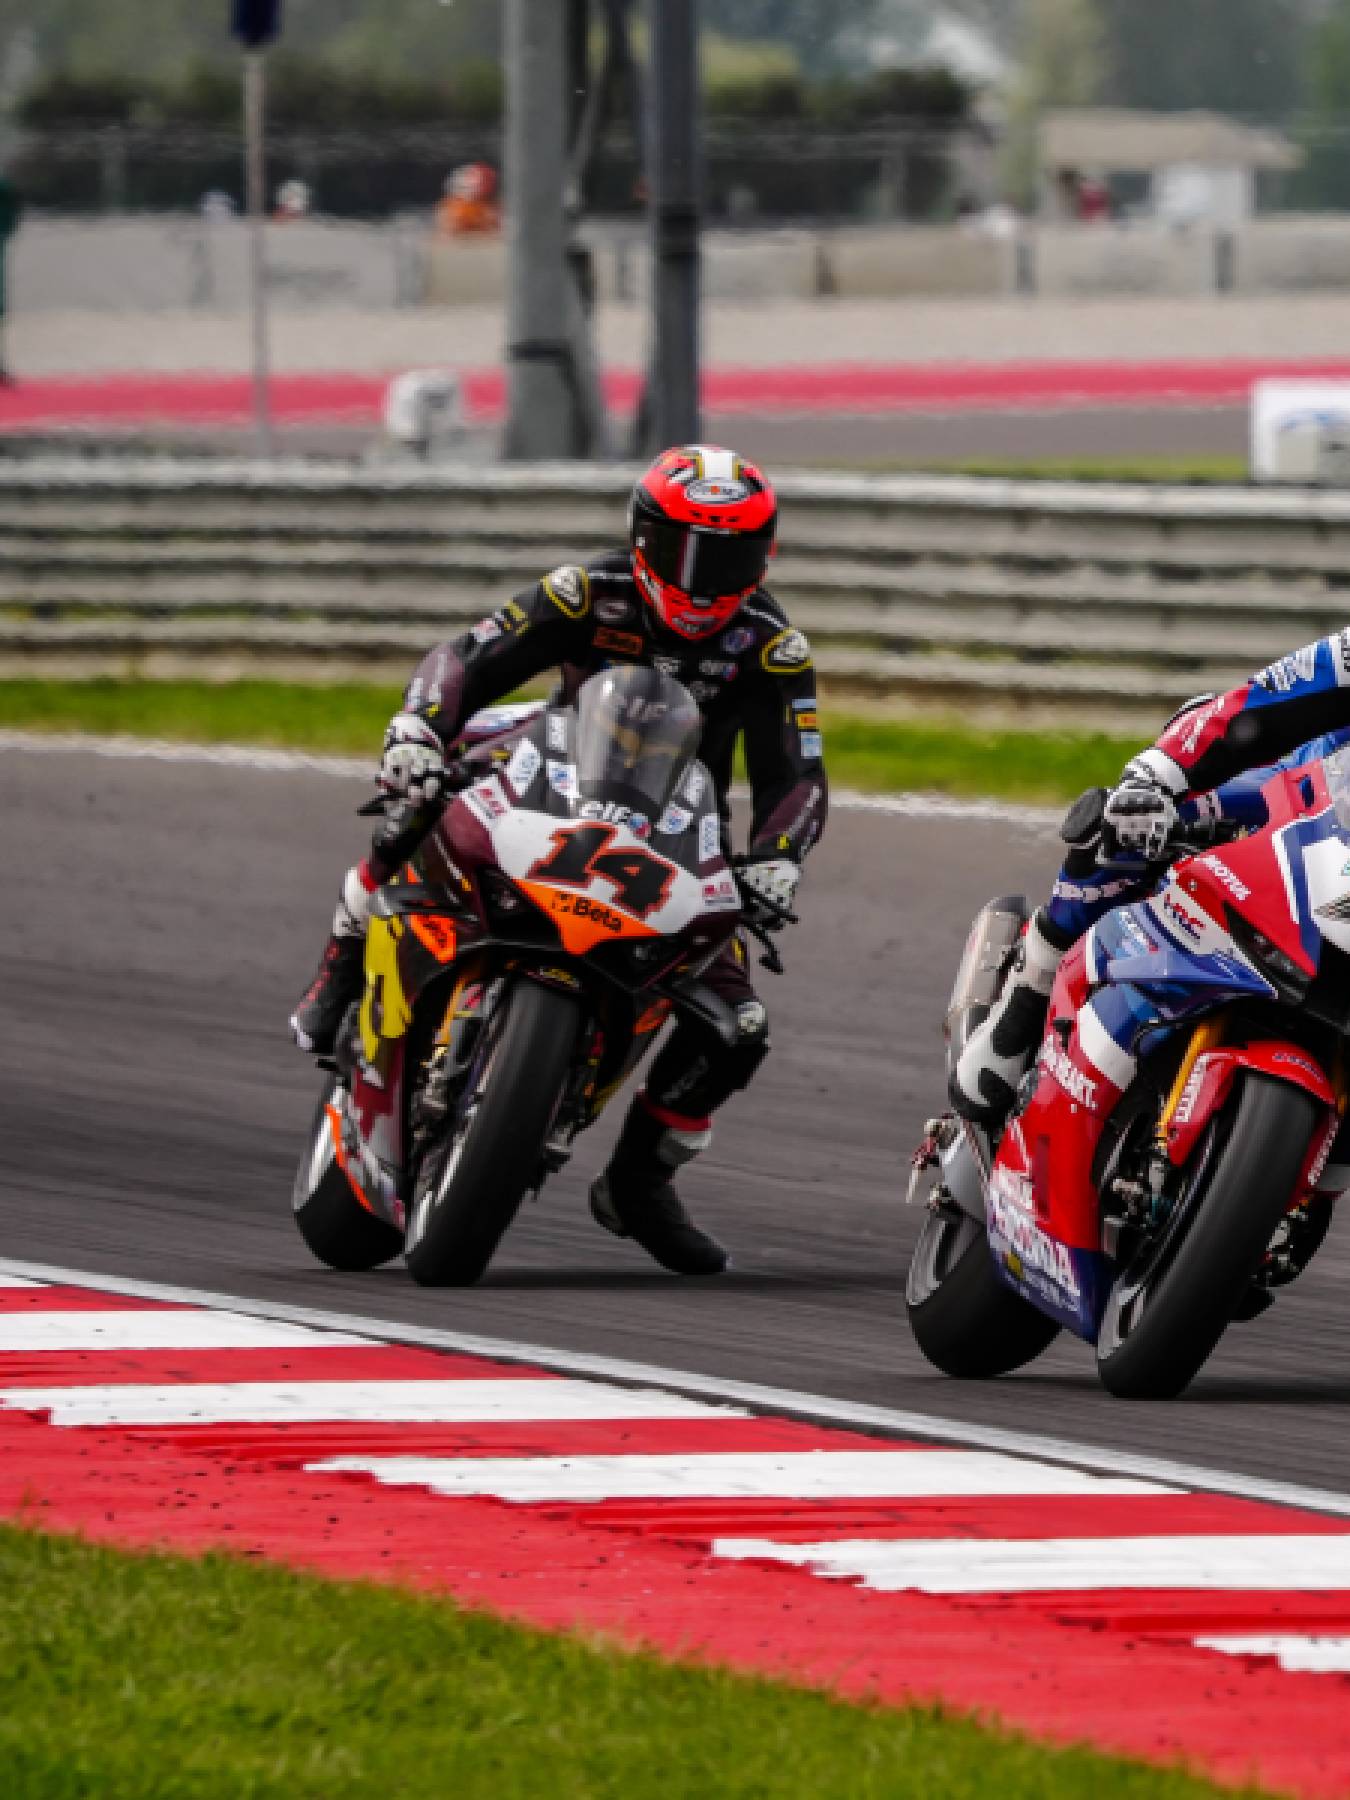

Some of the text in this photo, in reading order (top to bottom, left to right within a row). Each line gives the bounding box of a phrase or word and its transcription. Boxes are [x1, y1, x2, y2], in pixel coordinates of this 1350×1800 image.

[526, 821, 678, 923] 14
[1201, 855, 1253, 899] MOTUL
[572, 898, 623, 933] Beta
[1163, 891, 1208, 936] HRC
